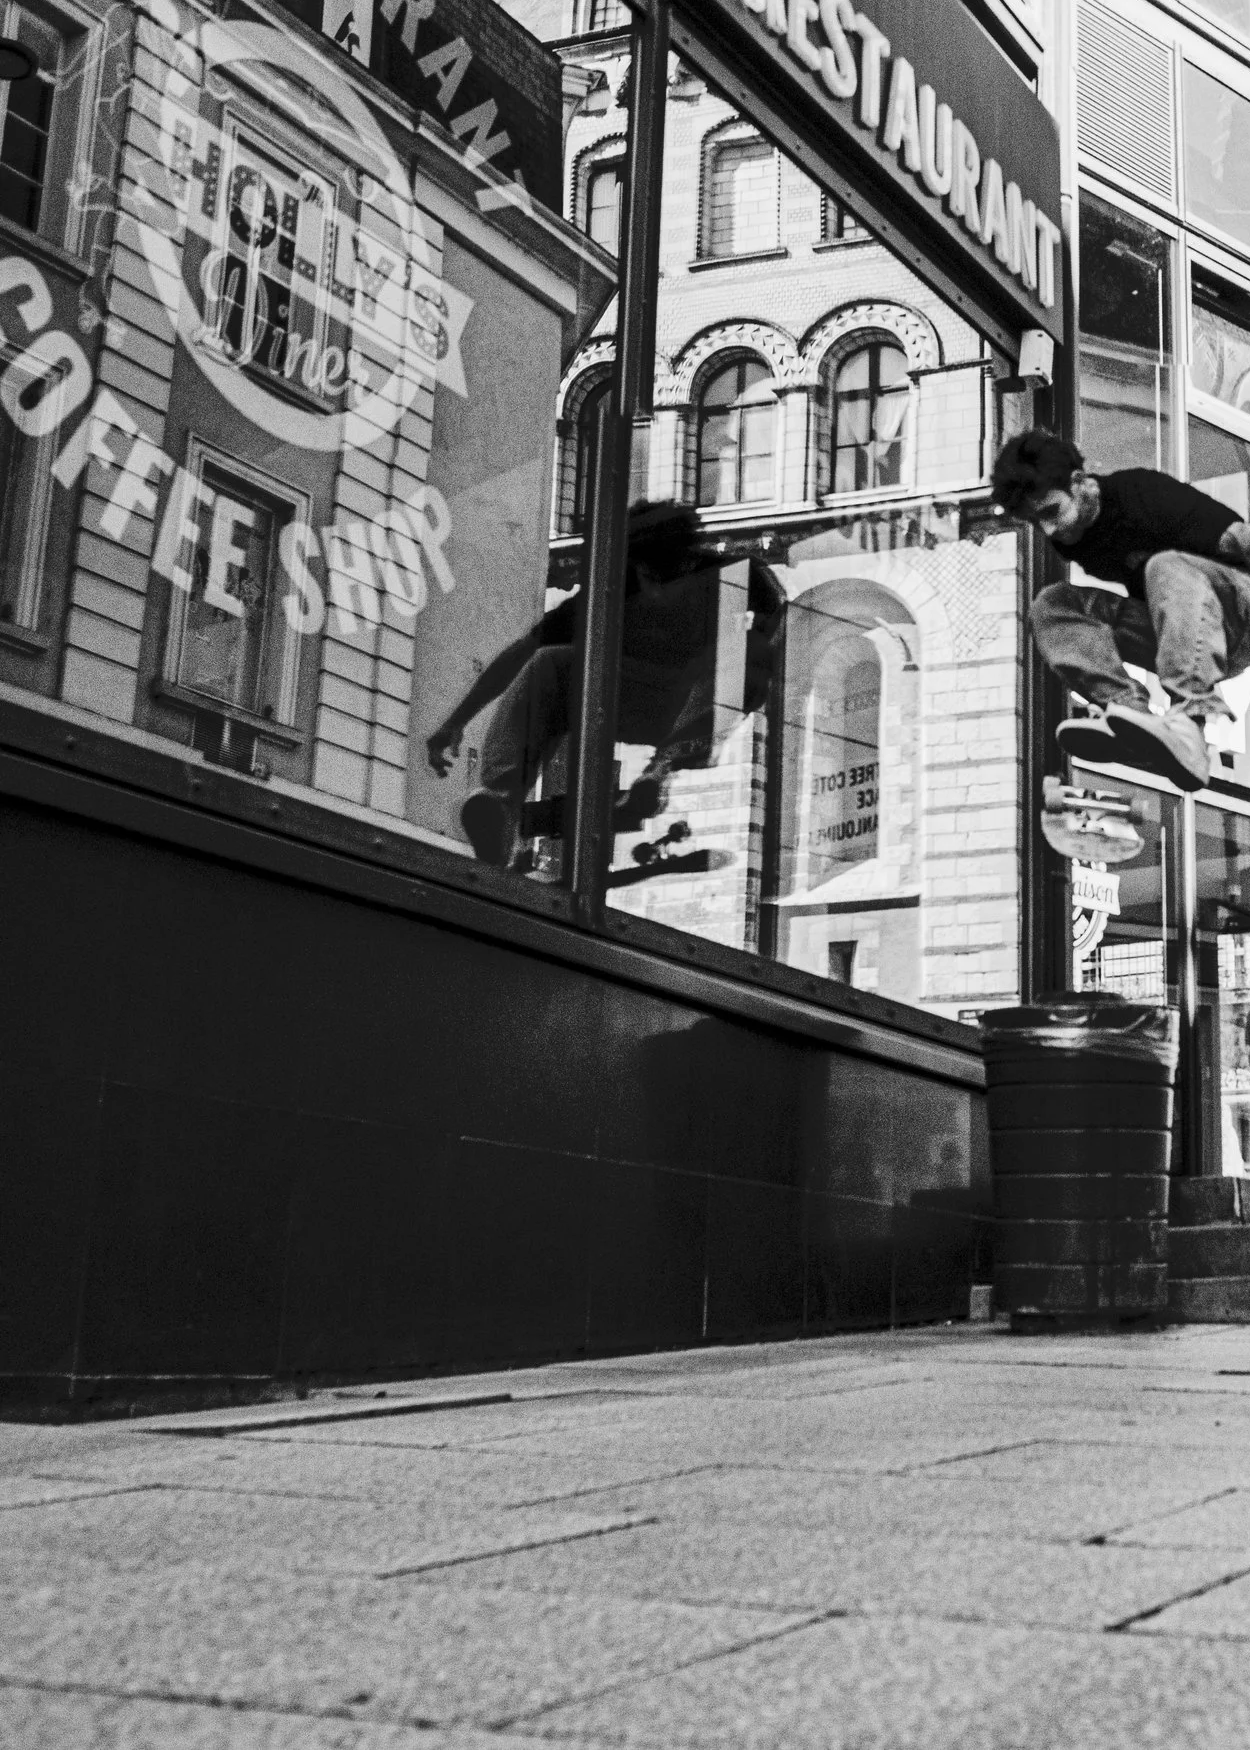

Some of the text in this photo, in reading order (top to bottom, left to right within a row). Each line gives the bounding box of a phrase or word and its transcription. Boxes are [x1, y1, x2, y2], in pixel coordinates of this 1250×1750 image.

[171, 117, 450, 361] HOLLY'S
[198, 248, 370, 410] Diner
[0, 256, 456, 635] COFFEE SHOP
